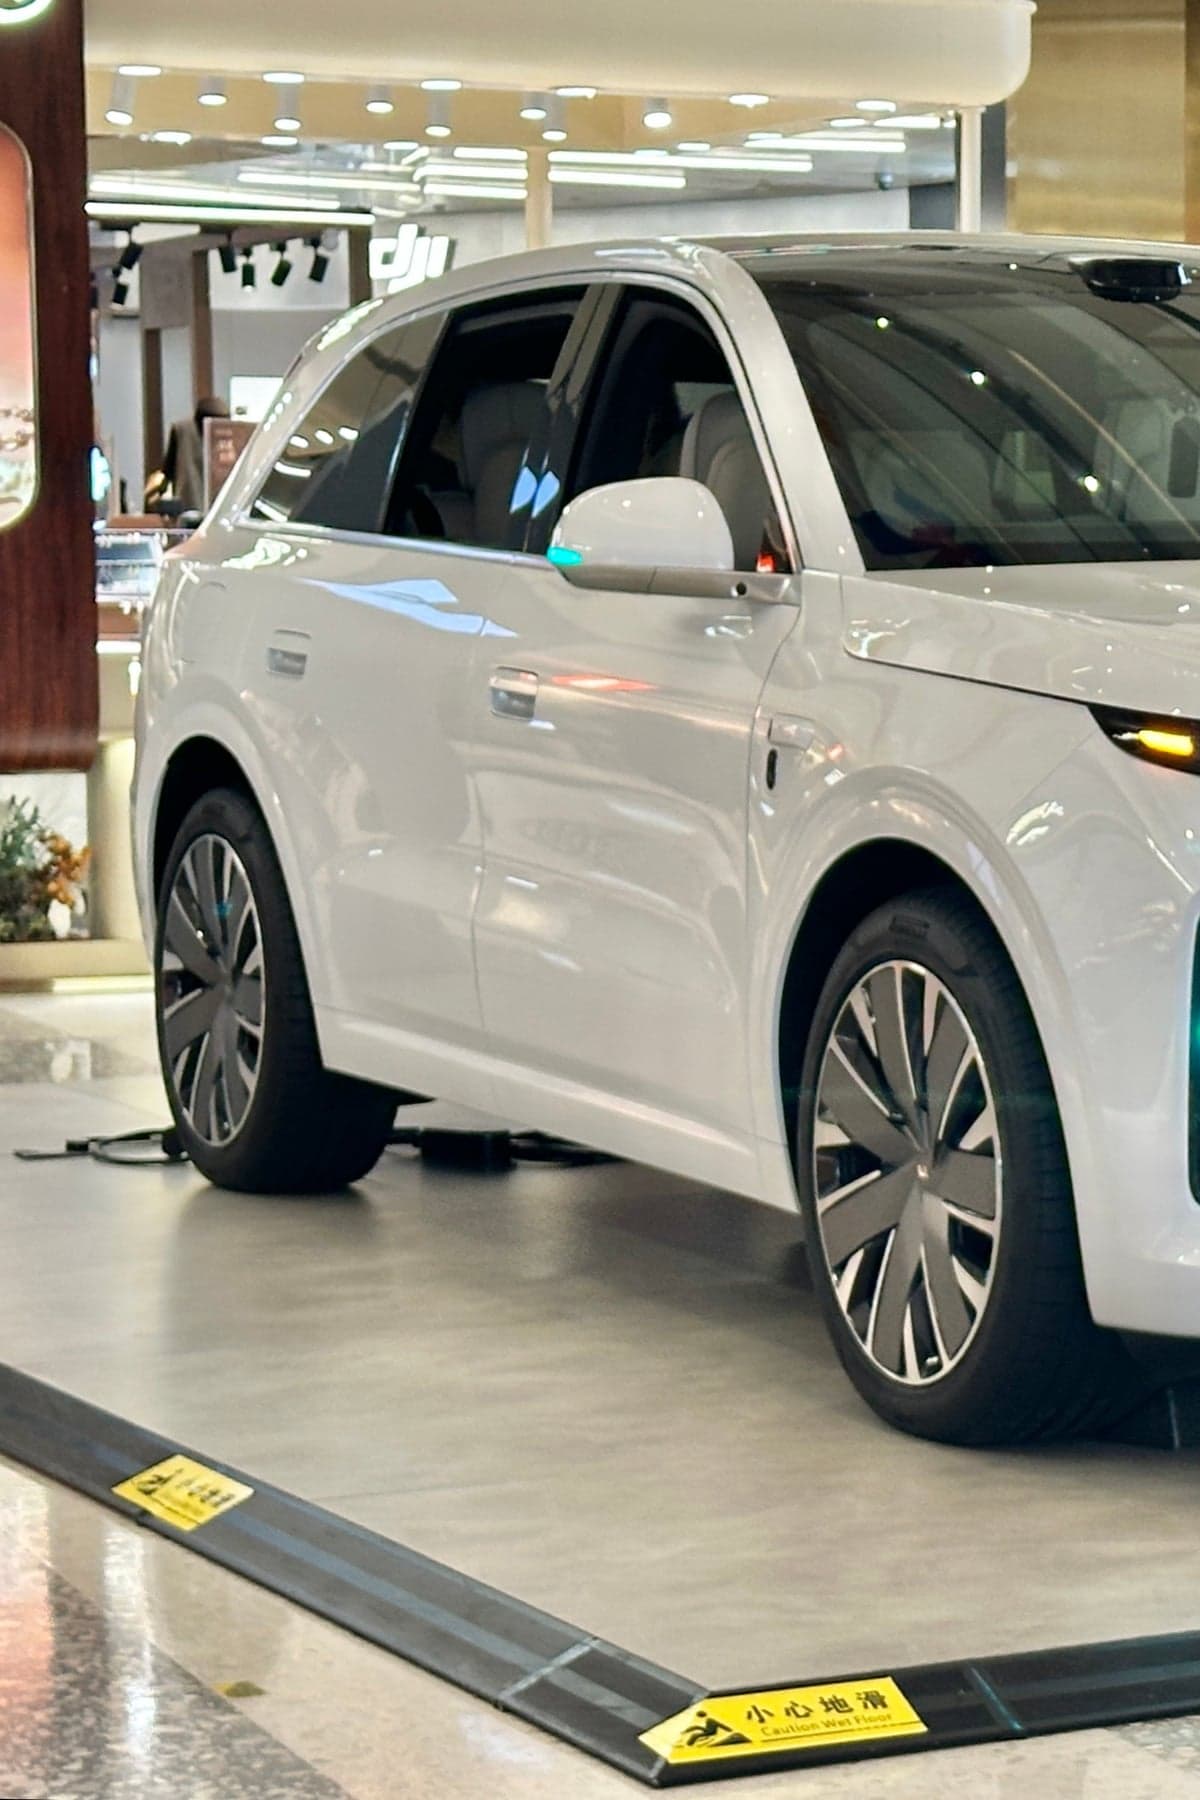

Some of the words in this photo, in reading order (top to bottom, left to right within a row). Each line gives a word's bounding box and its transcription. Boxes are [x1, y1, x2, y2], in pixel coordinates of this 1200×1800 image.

[746, 1690, 889, 1724] 小心地滑
[760, 1718, 820, 1737] Caution
[820, 1717, 853, 1730] Wet
[854, 1713, 893, 1726] Floor
